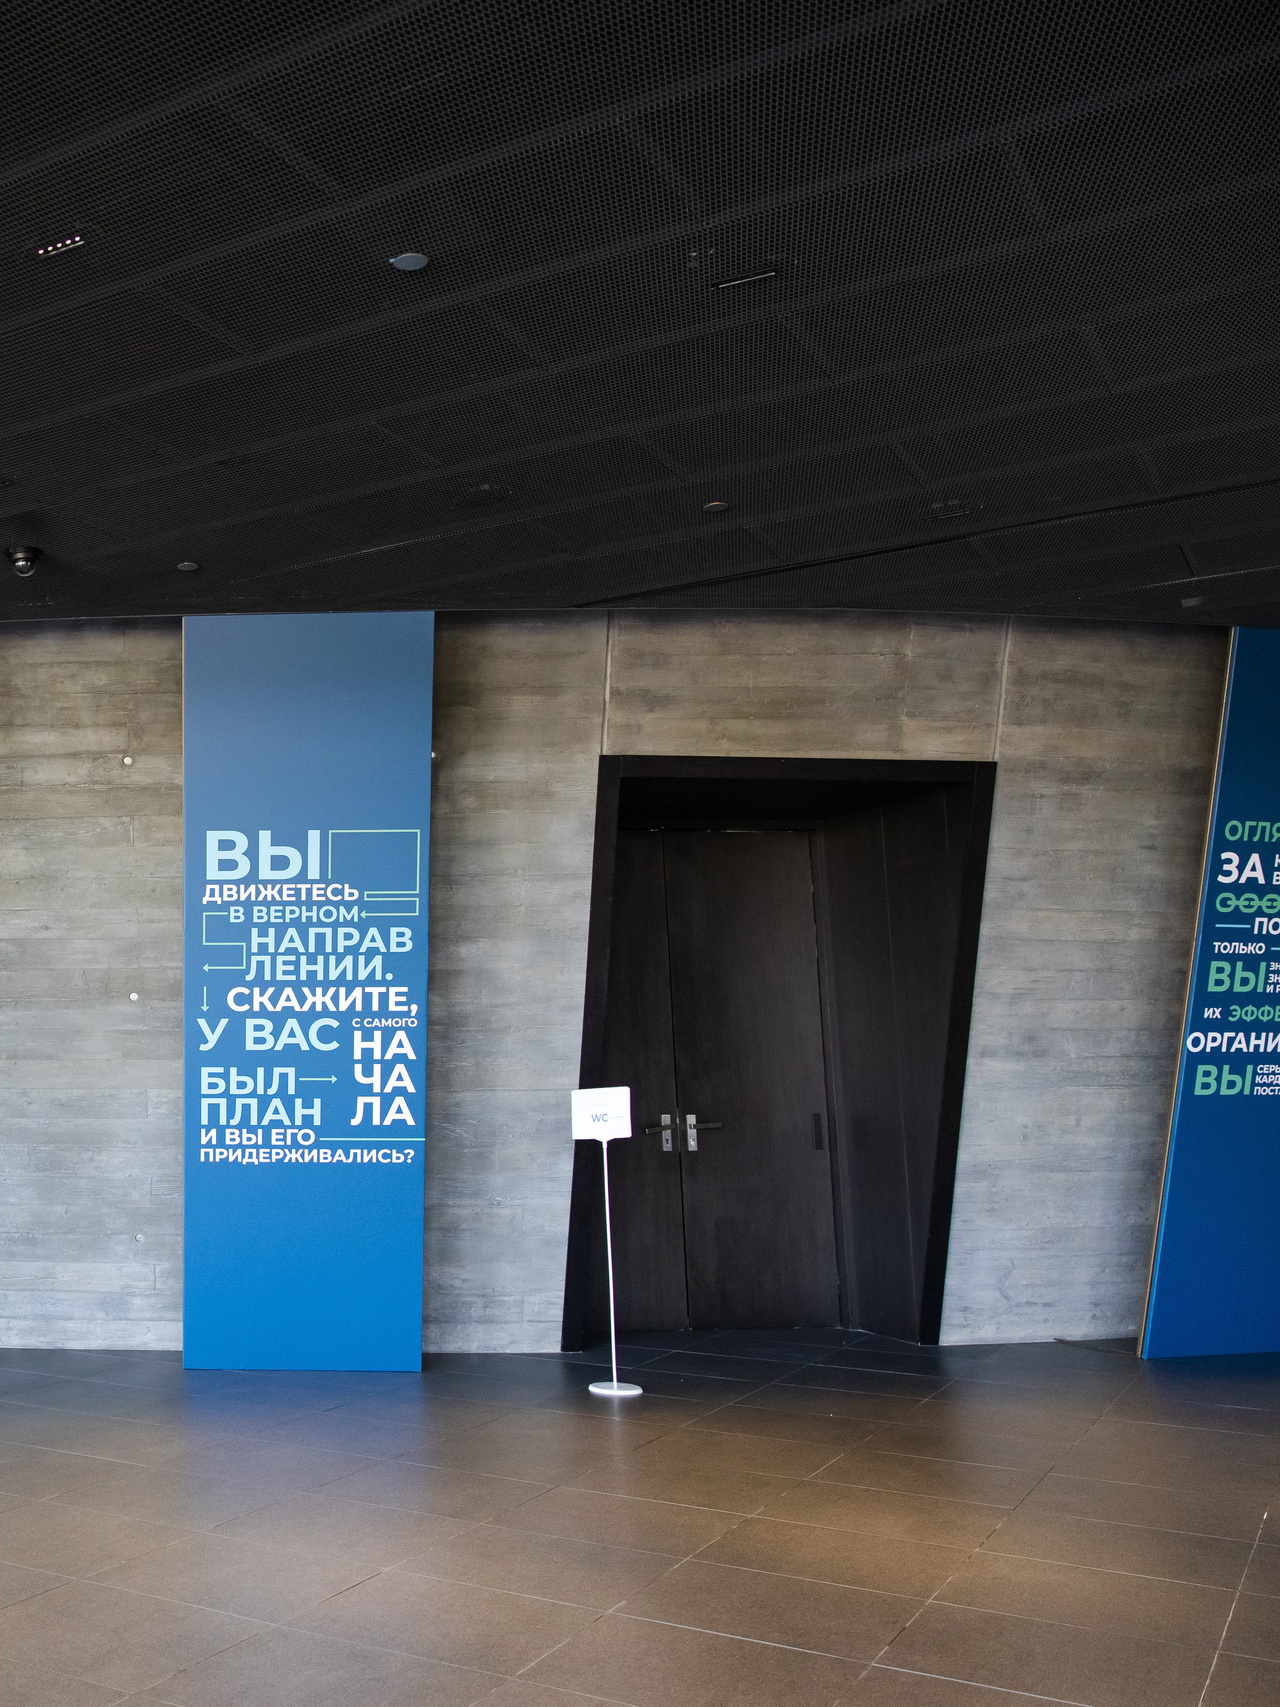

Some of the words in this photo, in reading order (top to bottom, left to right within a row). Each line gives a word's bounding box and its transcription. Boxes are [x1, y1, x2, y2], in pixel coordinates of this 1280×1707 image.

[206, 829, 320, 880] ВЫ
[1217, 852, 1266, 885] ЗА
[202, 883, 359, 904] ДВИЖЕТЕСЬ
[228, 906, 245, 923] В
[253, 905, 359, 923] ВЕРНОМ
[251, 926, 414, 953] НАПРАВ
[1213, 942, 1266, 954] ТОЛЬКО
[245, 954, 394, 981] ЛЕНИИ.
[1207, 960, 1267, 993] ВЫ
[226, 986, 419, 1017] СКАЖИТЕ,
[1203, 1007, 1222, 1019] ИХ
[196, 1017, 229, 1051] У
[245, 1017, 340, 1052] ВАС
[352, 1018, 361, 1028] С
[363, 1017, 418, 1028] САМОГО
[353, 1030, 417, 1060] НА
[200, 1066, 296, 1095] БЫЛ
[353, 1063, 416, 1093] ЧА
[1193, 1064, 1253, 1096] ВЫ
[200, 1097, 321, 1126] ПЛАН
[350, 1096, 416, 1126] ЛА
[591, 1113, 608, 1123] WC
[200, 1129, 217, 1145] И
[225, 1128, 263, 1145] ВЫ
[270, 1128, 316, 1146] ЕГО
[199, 1148, 415, 1165] ПРИДЕРЖИВАЛИСЬ?
